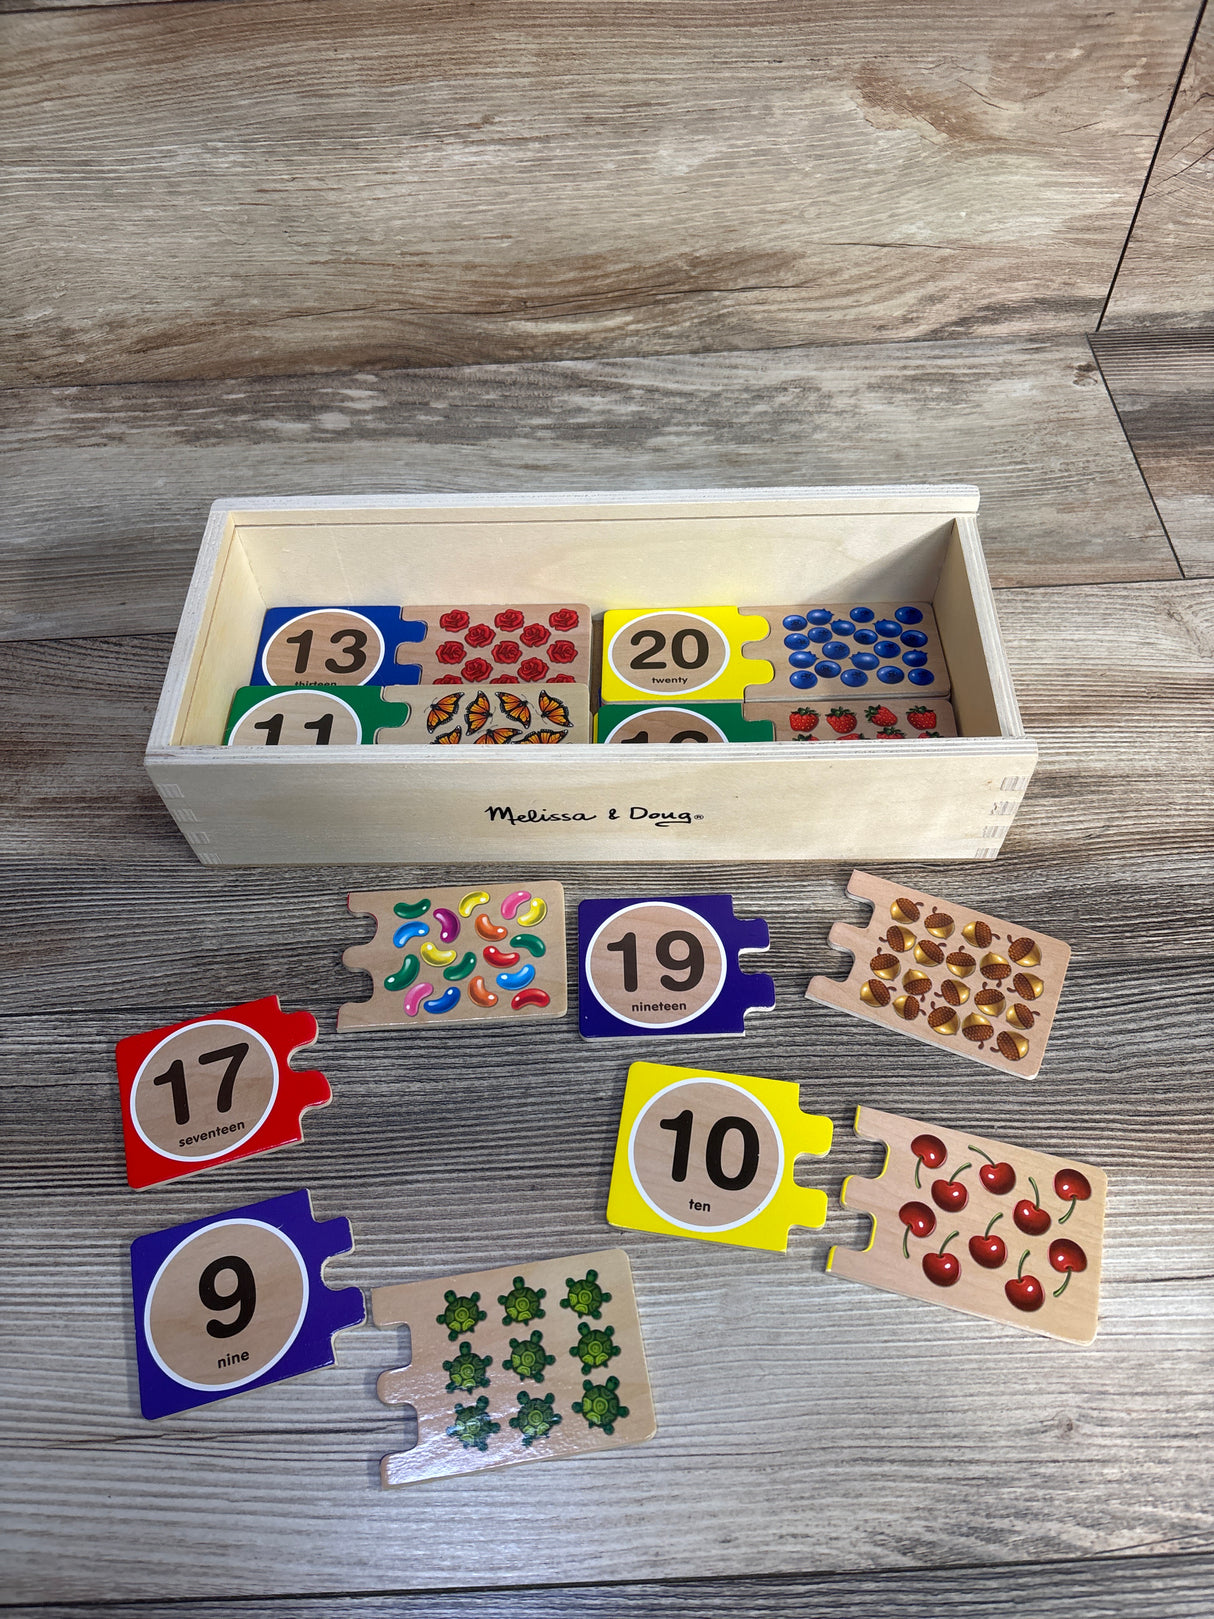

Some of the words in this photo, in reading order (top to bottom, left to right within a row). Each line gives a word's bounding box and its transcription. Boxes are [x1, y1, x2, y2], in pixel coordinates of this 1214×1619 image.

[286, 629, 368, 674] 13
[629, 628, 709, 670] 20
[651, 676, 688, 685] twenty
[254, 713, 334, 745] 11
[484, 806, 597, 826] Melissa
[608, 808, 621, 820] &
[606, 930, 705, 993] 19
[631, 1001, 687, 1012] nineteen
[153, 1042, 249, 1125] 17
[178, 1120, 245, 1147] seventeen
[659, 1109, 760, 1191] 10
[688, 1199, 711, 1212] ten
[198, 1255, 257, 1339] 9
[217, 1349, 250, 1369] nine
